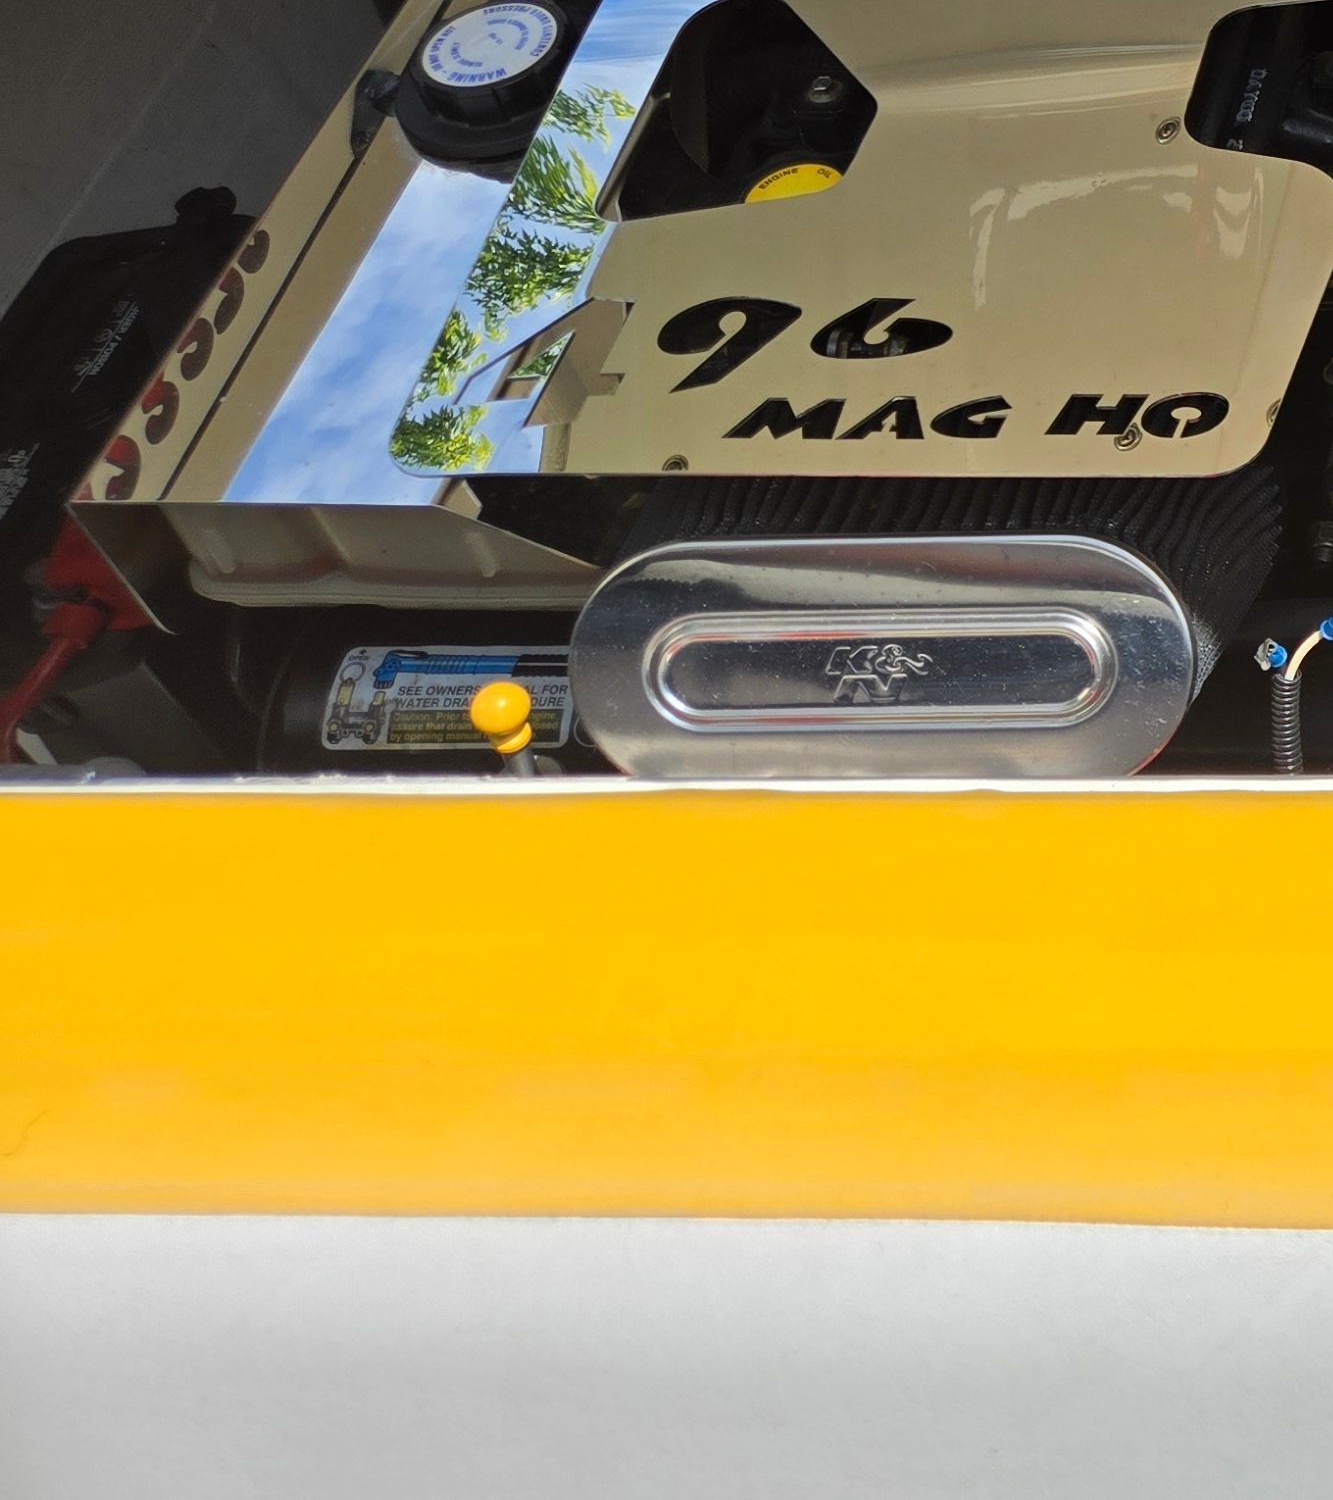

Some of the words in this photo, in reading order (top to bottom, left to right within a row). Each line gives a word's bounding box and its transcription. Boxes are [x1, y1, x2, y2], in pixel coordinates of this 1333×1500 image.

[447, 68, 507, 81] WARNING
[758, 168, 798, 190] ENGINE
[816, 168, 832, 179] OIL
[721, 393, 1013, 440] MAG
[1044, 391, 1229, 439] HO
[397, 685, 423, 696] SEE
[426, 685, 479, 696] OWNERS
[541, 684, 568, 695] FOR
[396, 697, 440, 708] WATER
[436, 712, 460, 721] Prior
[425, 721, 444, 729] that
[390, 732, 401, 742] by
[404, 732, 444, 742] opening
[446, 731, 481, 740] manual
